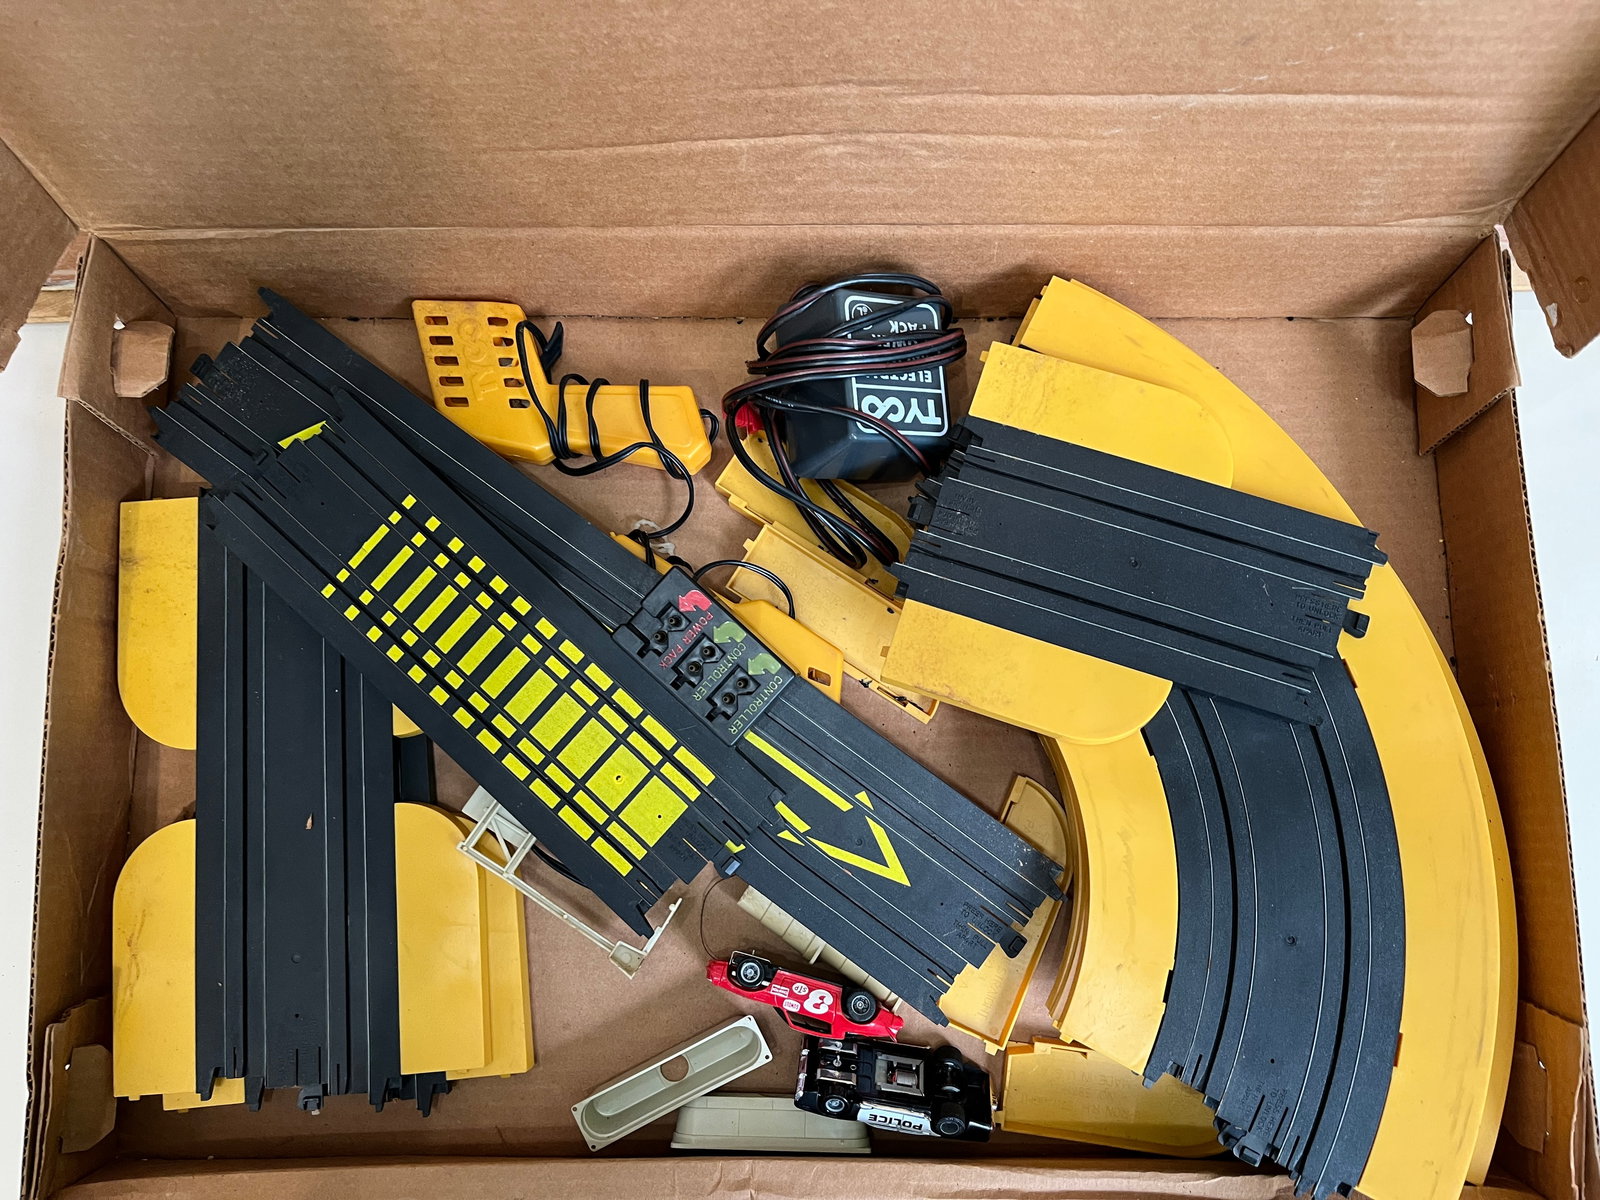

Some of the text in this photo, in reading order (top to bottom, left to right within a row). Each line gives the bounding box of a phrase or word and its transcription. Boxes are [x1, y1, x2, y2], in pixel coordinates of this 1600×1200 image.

[457, 317, 499, 401] TYCO
[861, 394, 942, 425] TYCO
[659, 612, 714, 669] POWER PACK
[693, 643, 746, 701] CONTROLLER
[729, 675, 782, 735] CONTROLLER
[962, 901, 1003, 933] PRESS HERE
[794, 985, 807, 993] STP
[803, 989, 833, 1014] 3
[869, 1114, 923, 1130] POLICE
